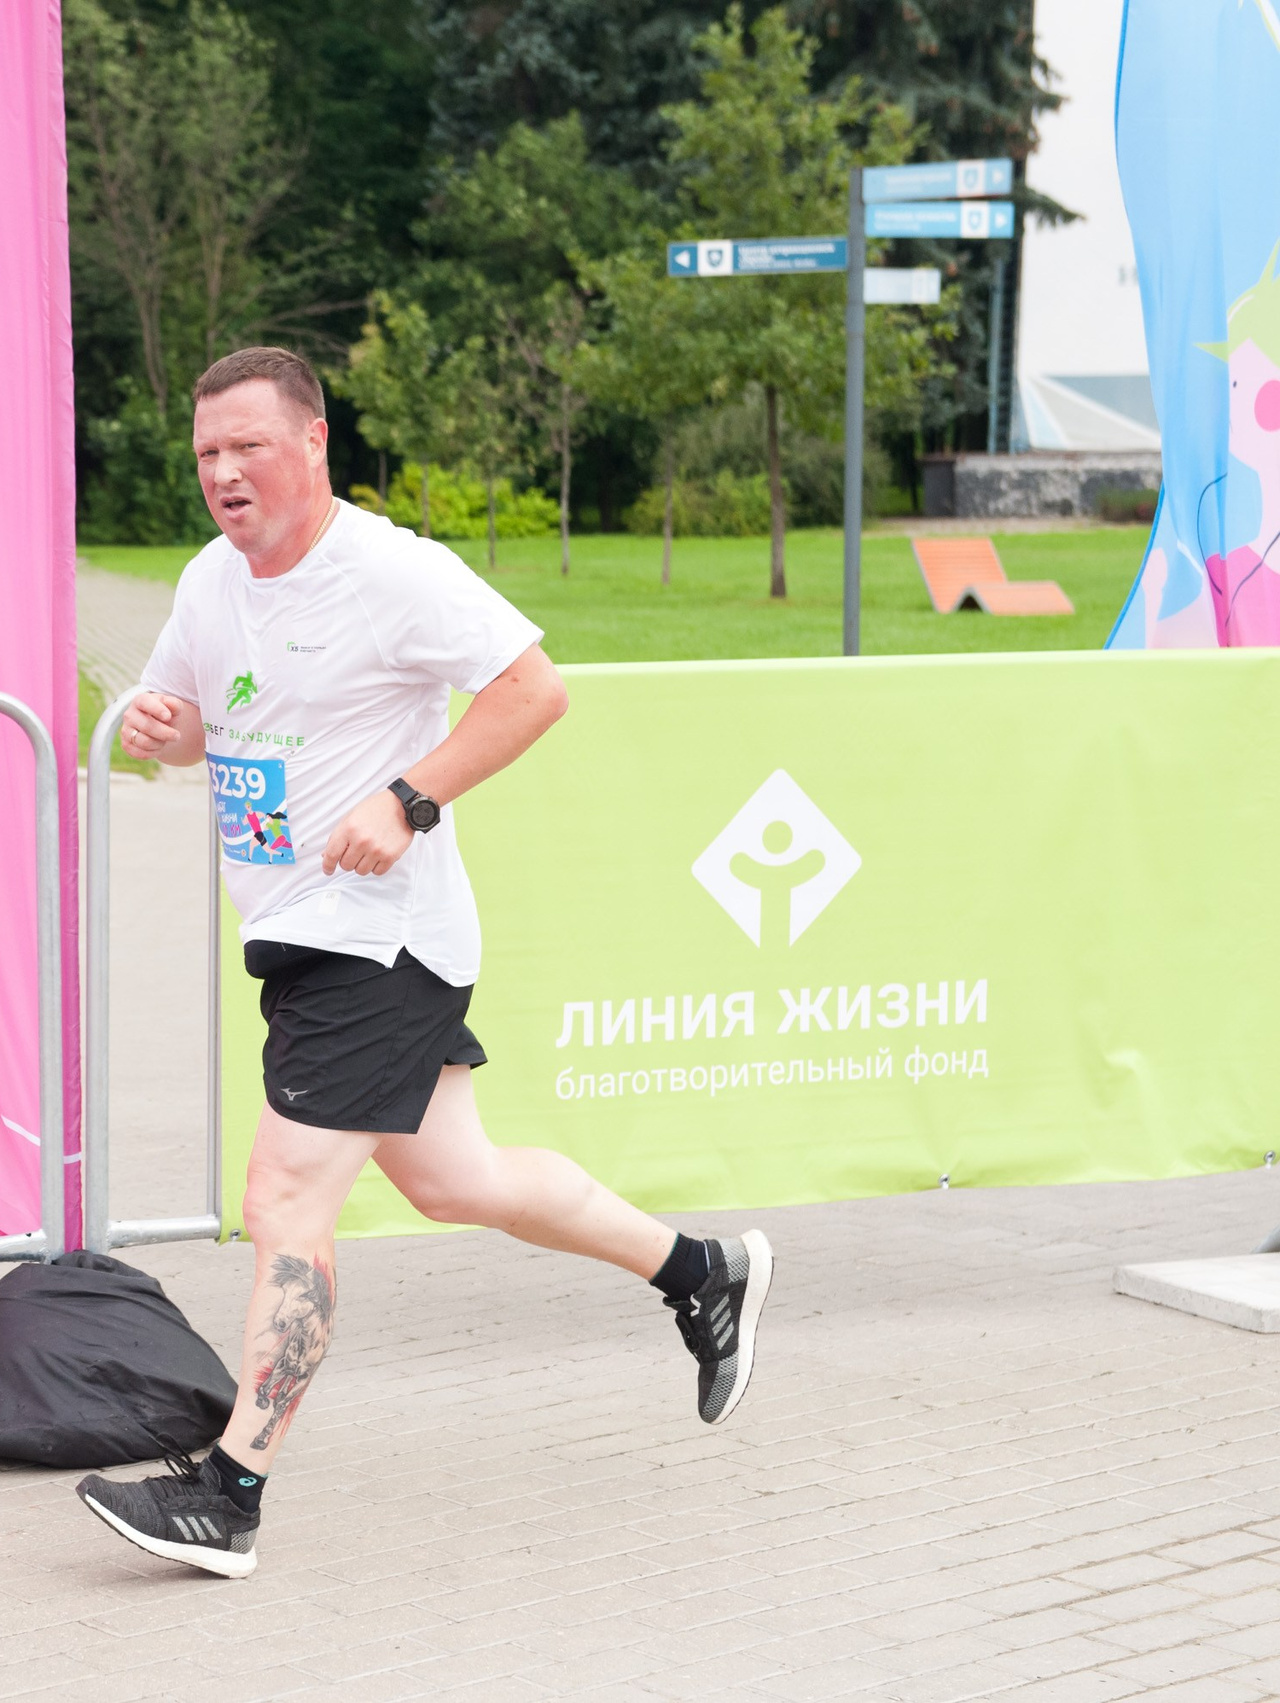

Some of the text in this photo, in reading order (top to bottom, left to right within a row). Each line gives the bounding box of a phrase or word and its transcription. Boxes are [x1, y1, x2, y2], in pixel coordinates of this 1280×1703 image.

[208, 761, 267, 800] 3239
[555, 978, 988, 1048] ЛИНИЯ ЖИЗНИ
[555, 1045, 989, 1100] благотворительный фонд
